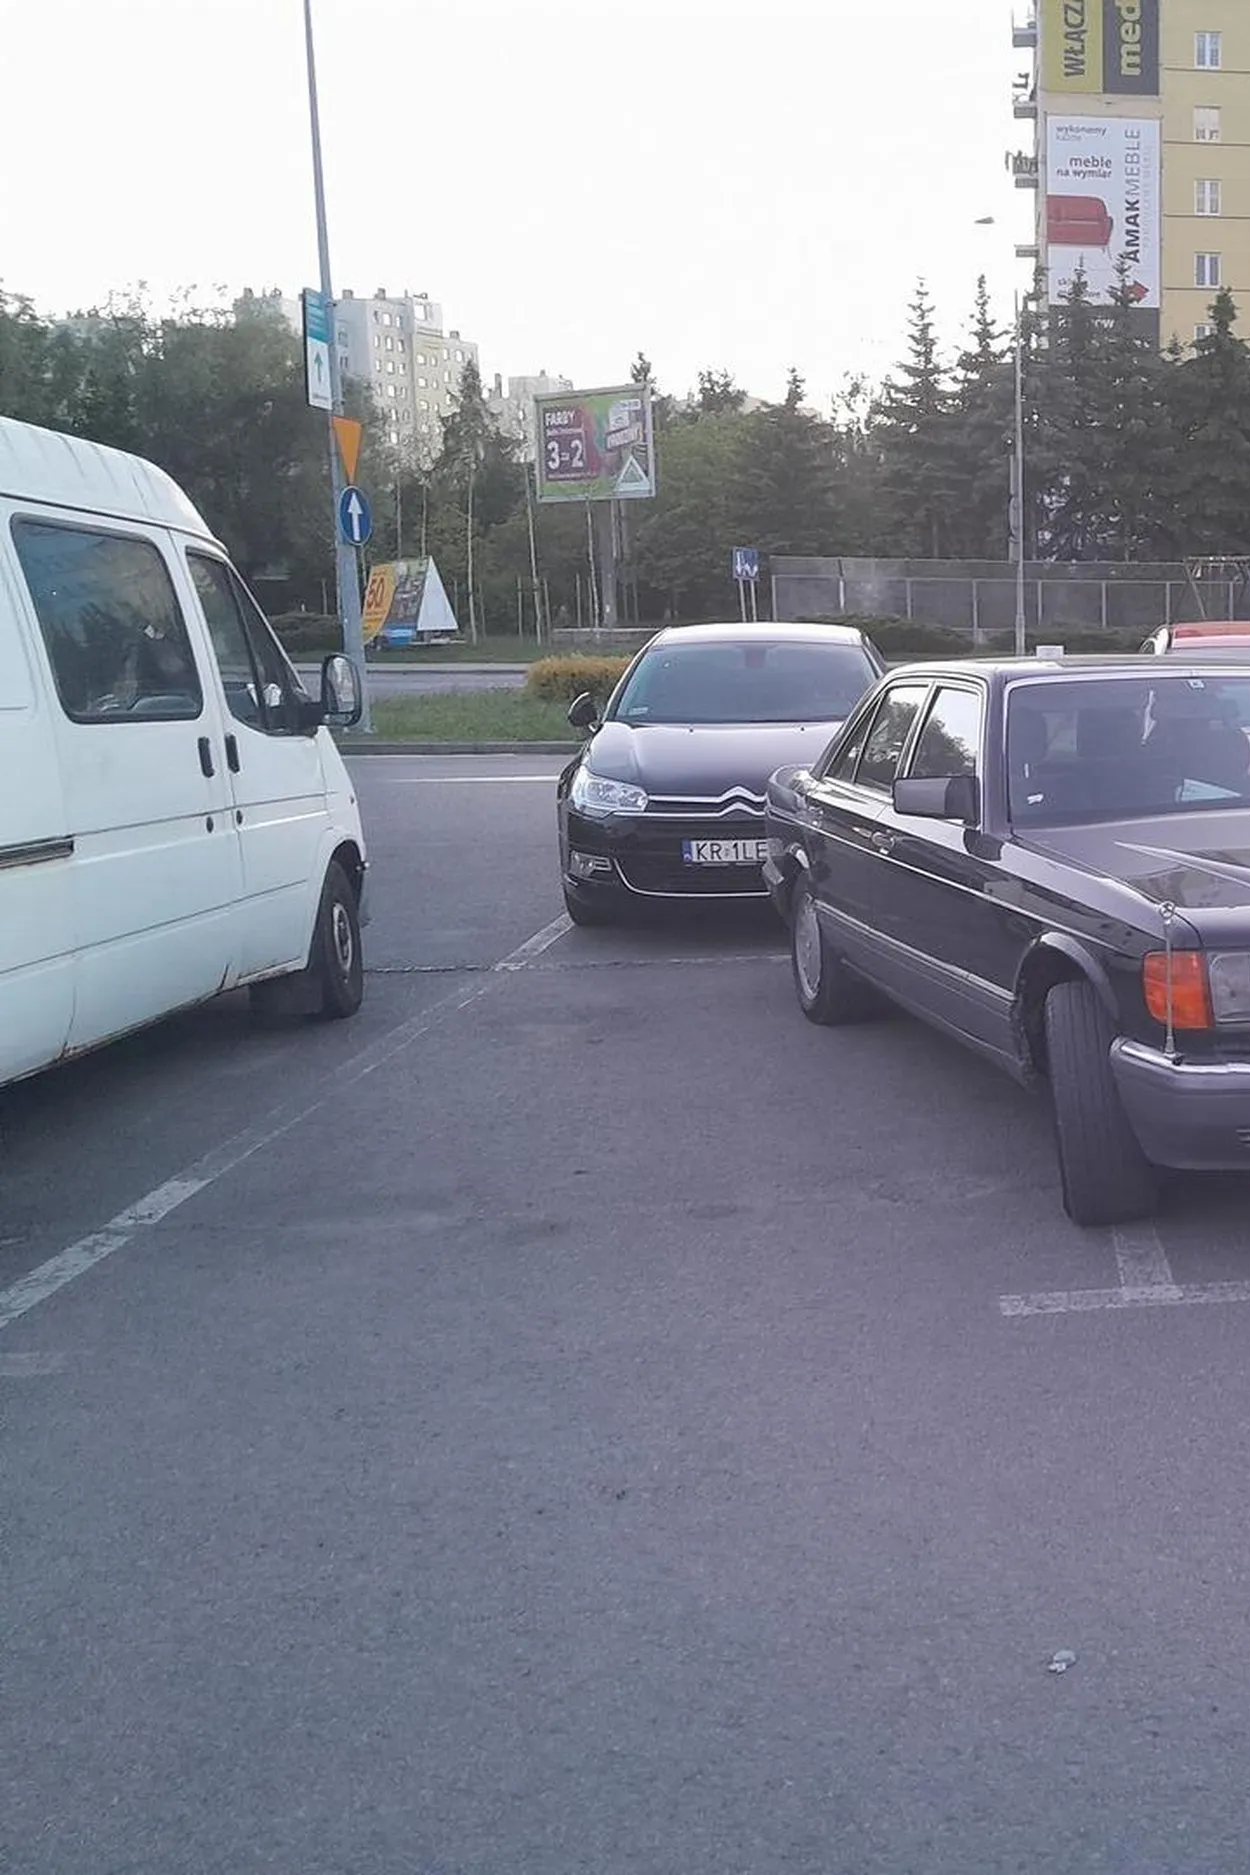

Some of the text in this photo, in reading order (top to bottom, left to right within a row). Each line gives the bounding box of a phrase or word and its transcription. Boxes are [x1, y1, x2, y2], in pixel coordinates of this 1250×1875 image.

[1069, 155, 1112, 168] meble
[1056, 168, 1070, 177] na
[696, 843, 722, 860] KR
